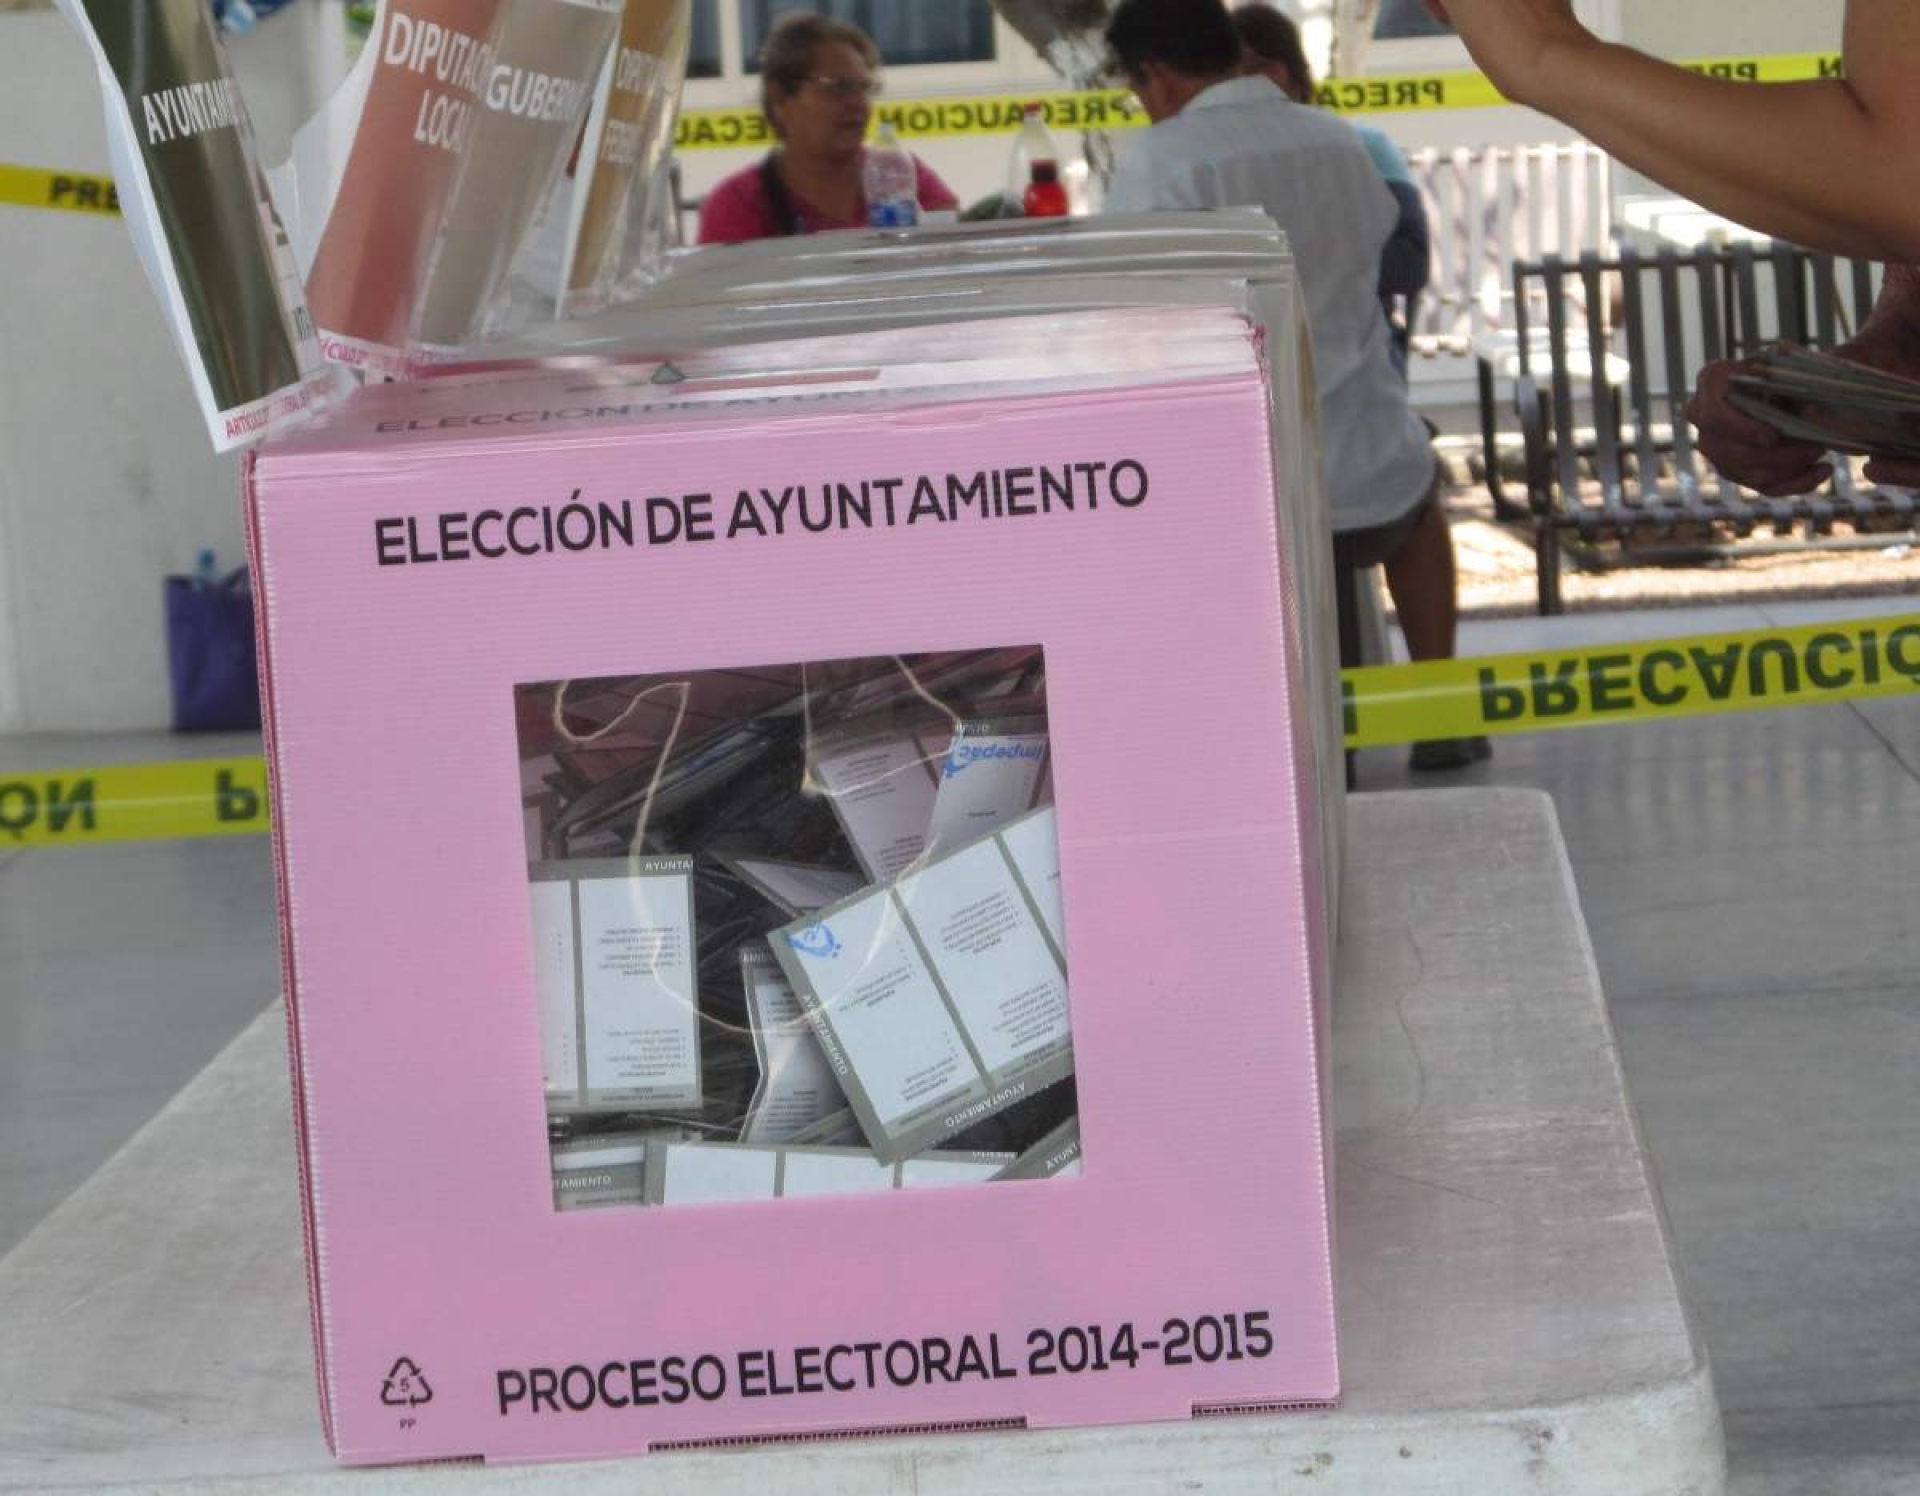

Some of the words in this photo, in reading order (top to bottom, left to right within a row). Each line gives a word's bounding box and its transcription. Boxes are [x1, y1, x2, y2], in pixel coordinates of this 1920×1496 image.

[375, 488, 634, 566] ELECCIÓN
[645, 493, 716, 546] DE
[726, 458, 1149, 539] AYUNTAMIENTO
[497, 1353, 727, 1416] PROCESO
[737, 1333, 1017, 1398] ELECTORAL
[1025, 1310, 1274, 1377] 2014-2015
